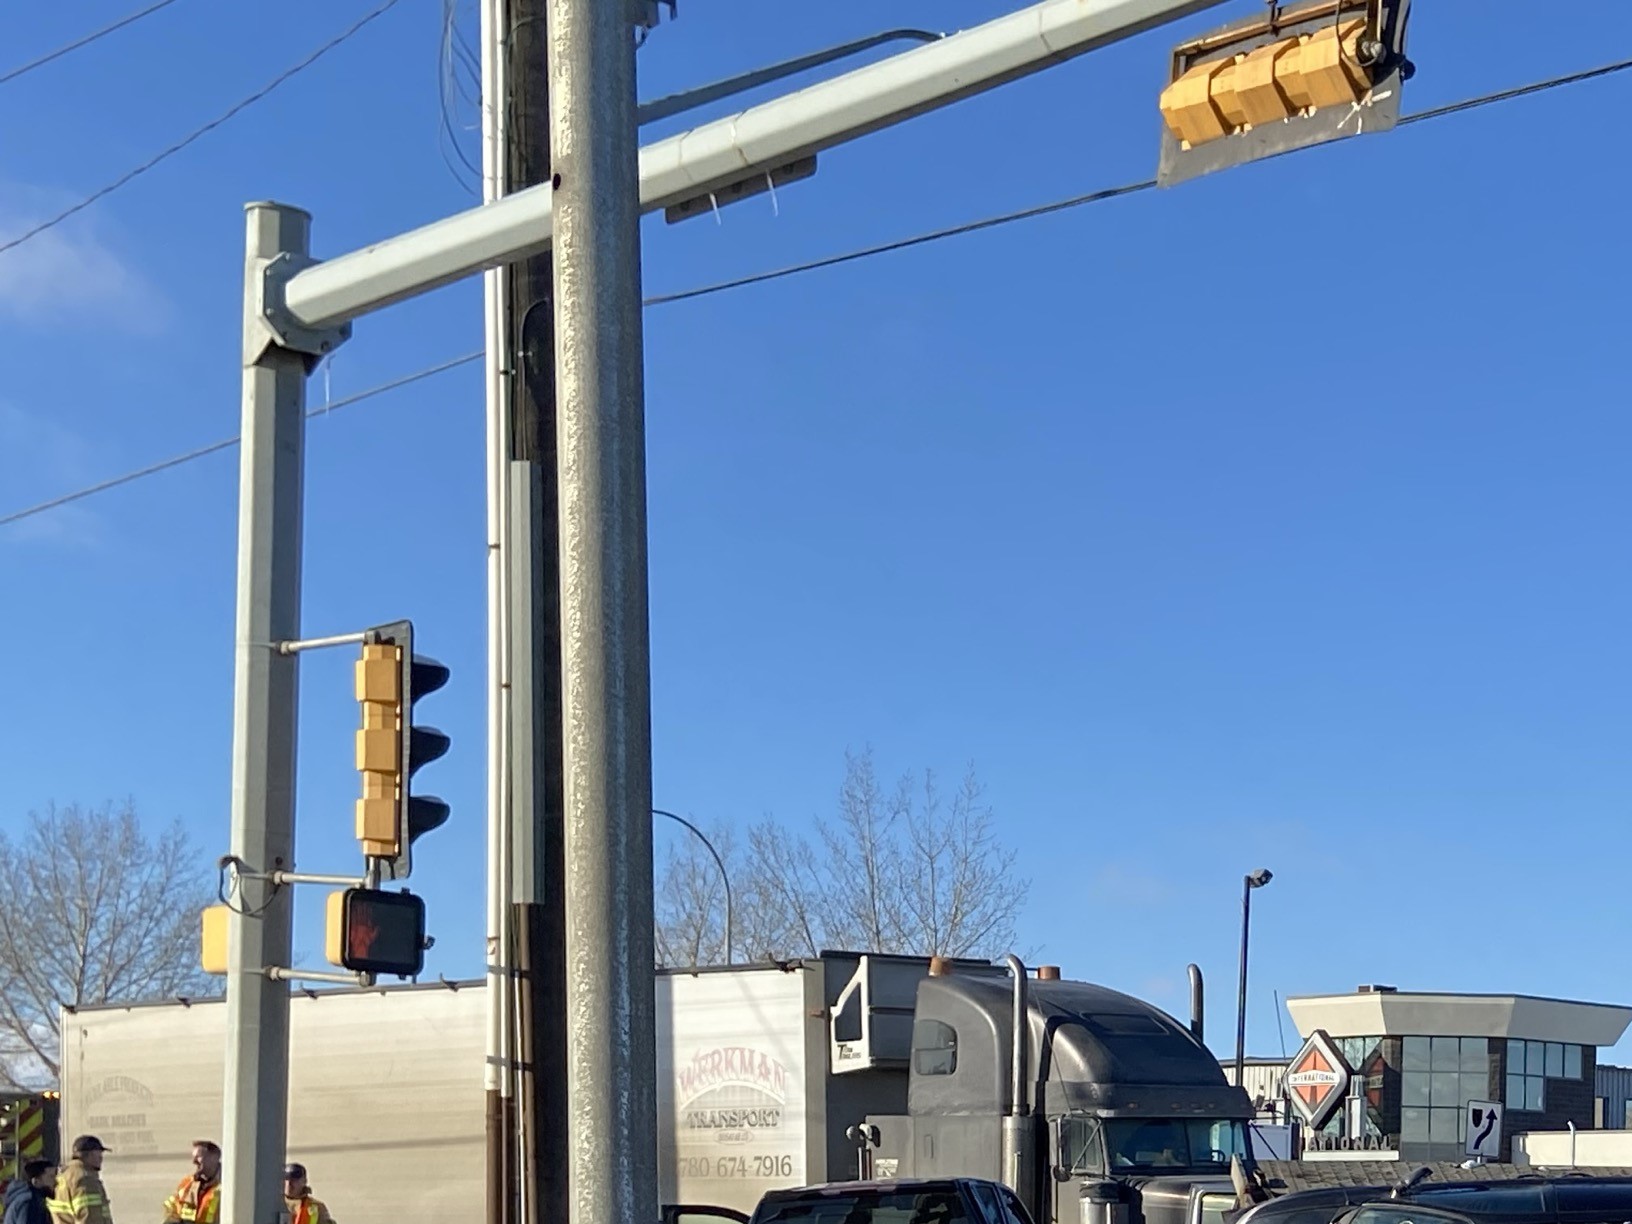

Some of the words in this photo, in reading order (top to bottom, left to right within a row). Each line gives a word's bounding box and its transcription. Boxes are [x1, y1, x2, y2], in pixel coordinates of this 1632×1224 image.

[680, 1047, 788, 1098] WERKMAN
[686, 1108, 781, 1129] TRANSPORT
[680, 1154, 793, 1178] 780-674-7916
